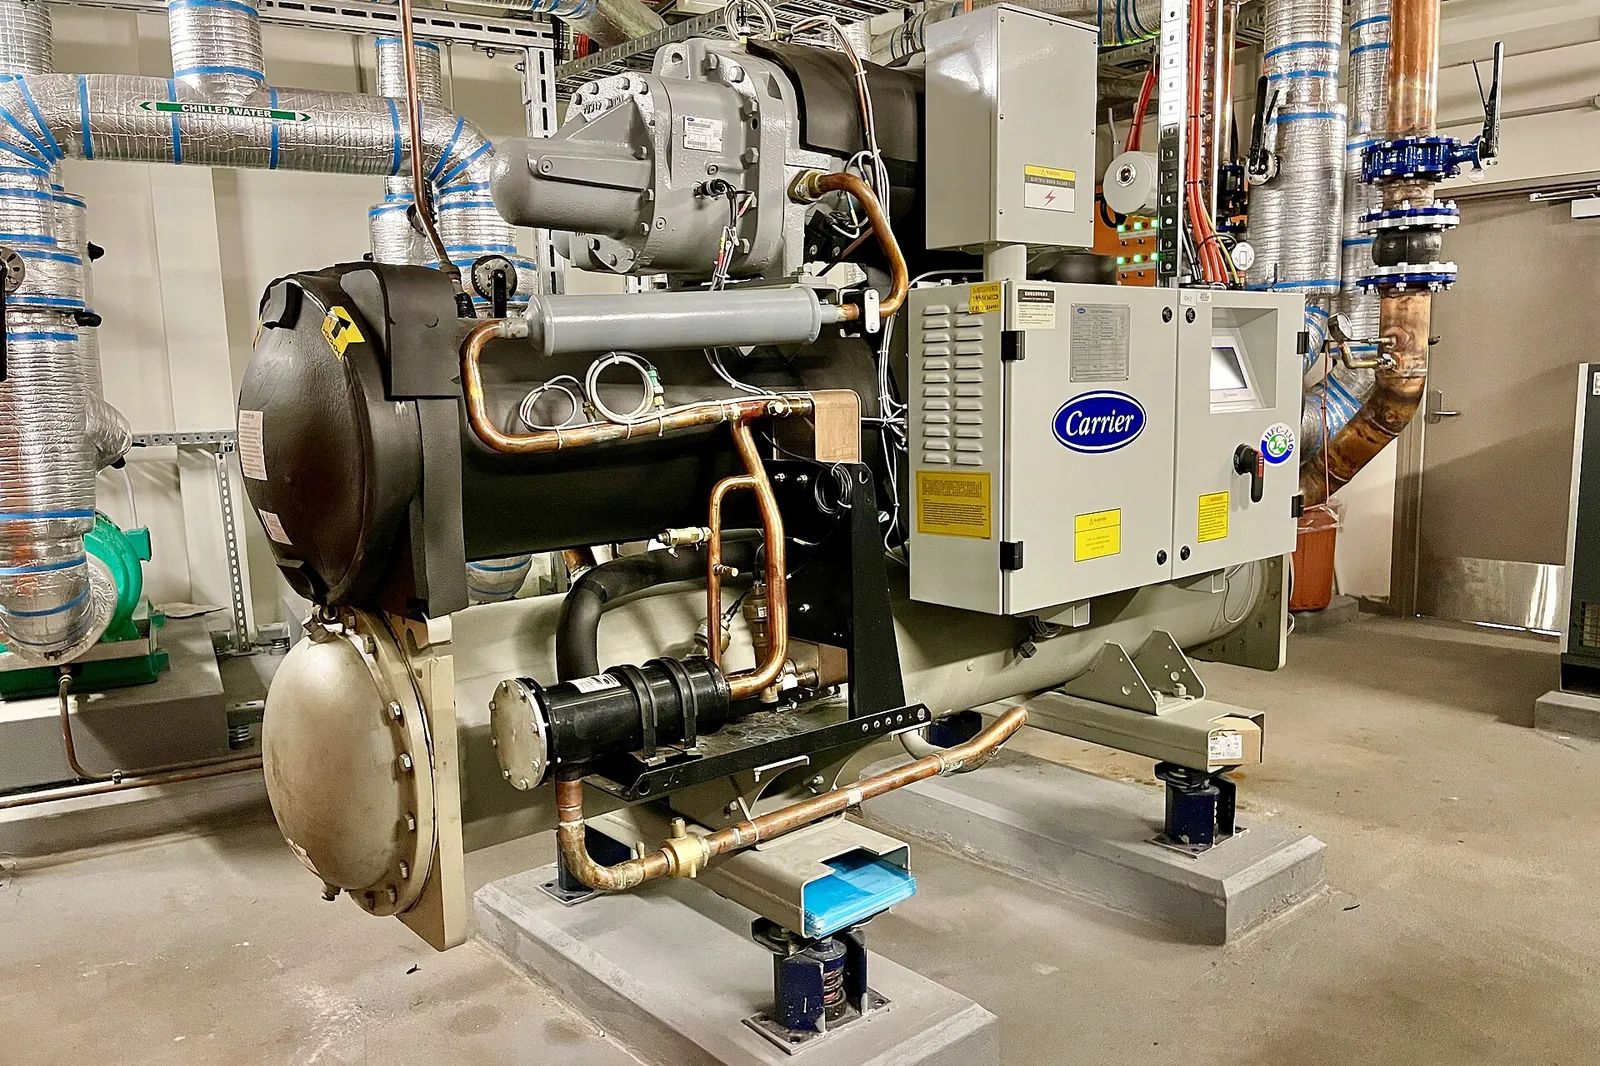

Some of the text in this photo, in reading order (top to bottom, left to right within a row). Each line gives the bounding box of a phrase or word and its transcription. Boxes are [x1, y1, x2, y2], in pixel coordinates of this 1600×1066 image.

[181, 104, 271, 118] CHILLED WATER
[1066, 410, 1134, 436] Carrier
